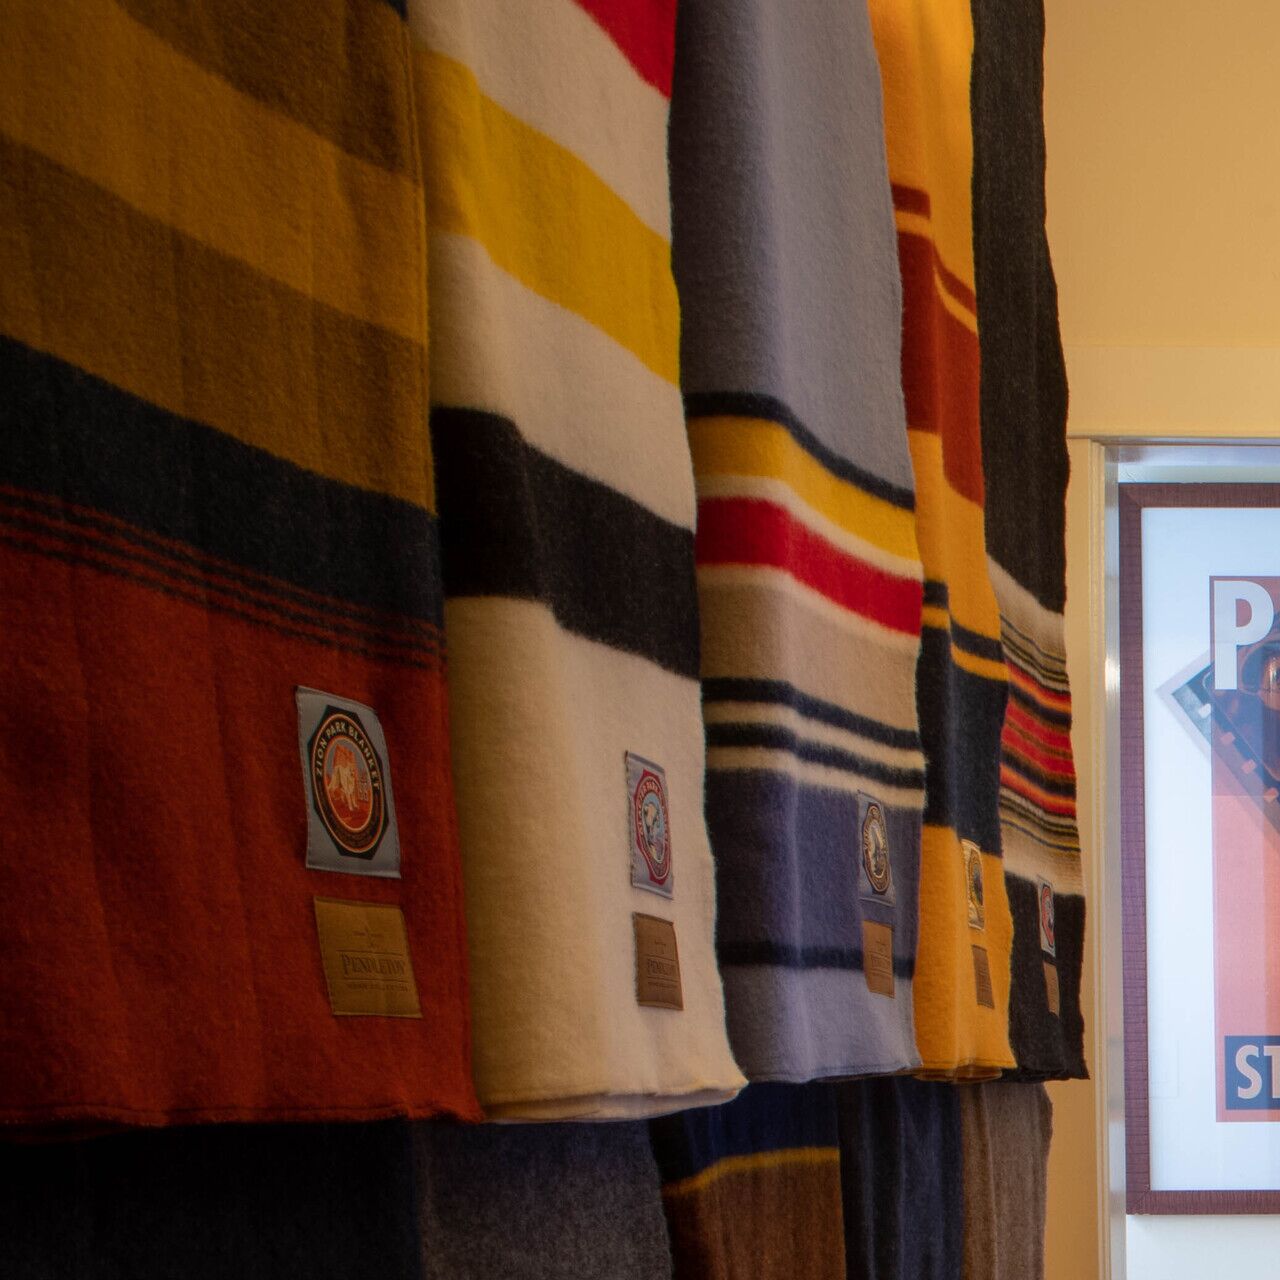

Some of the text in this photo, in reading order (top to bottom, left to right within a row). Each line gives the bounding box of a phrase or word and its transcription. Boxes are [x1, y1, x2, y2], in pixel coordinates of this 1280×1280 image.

[315, 721, 381, 791] ZION PARK BLANKET
